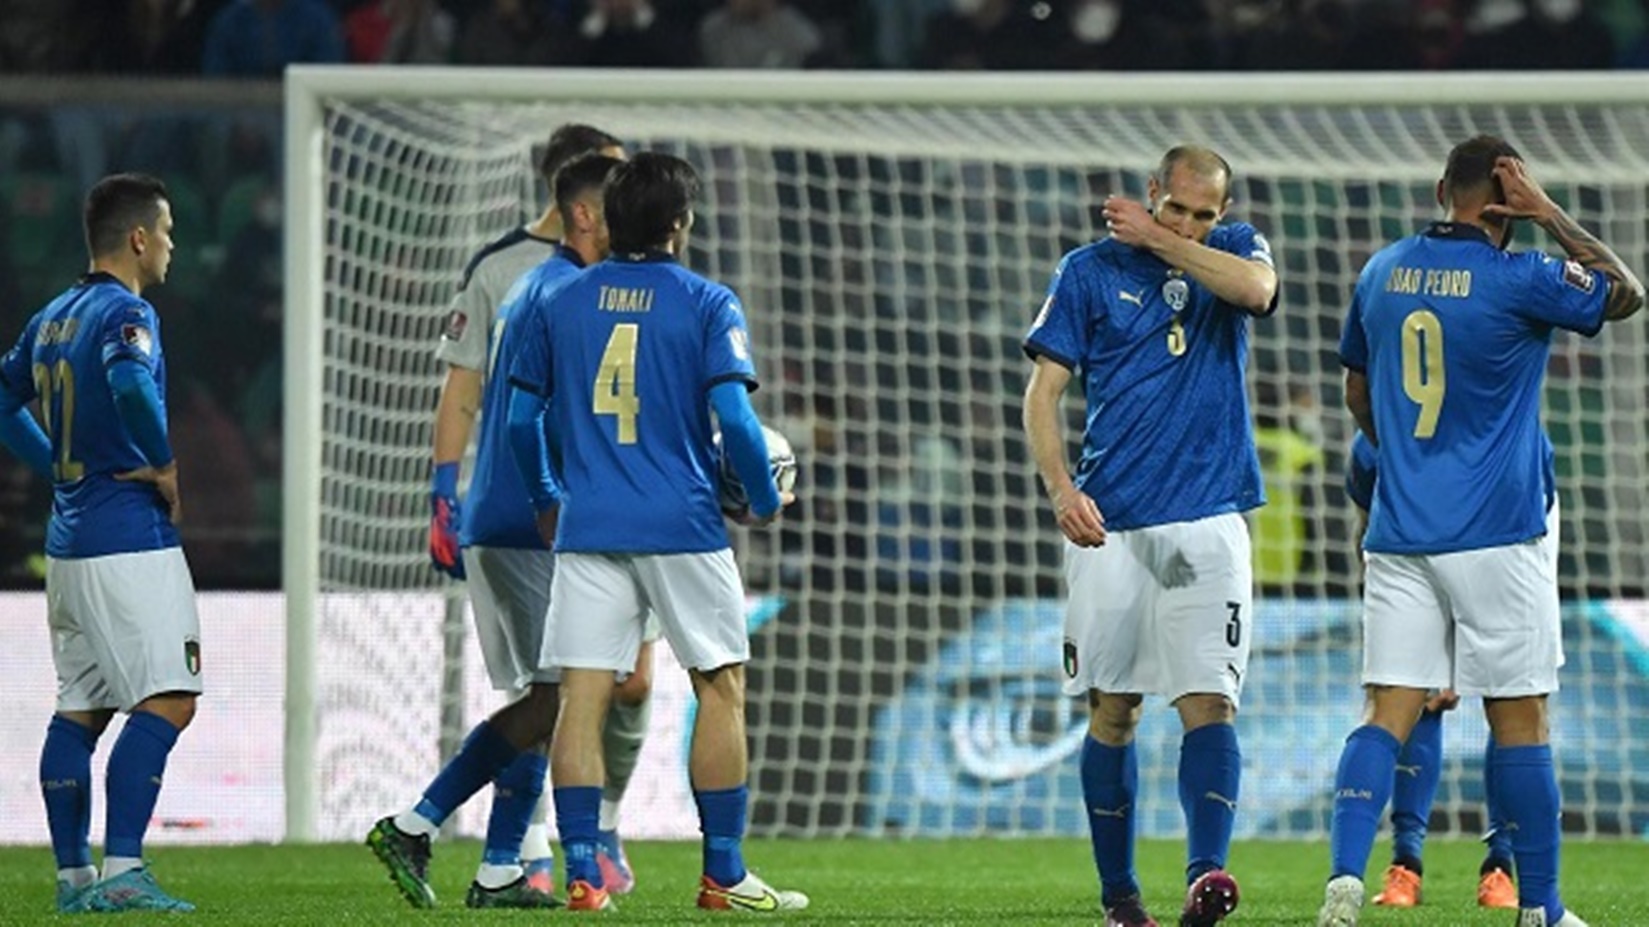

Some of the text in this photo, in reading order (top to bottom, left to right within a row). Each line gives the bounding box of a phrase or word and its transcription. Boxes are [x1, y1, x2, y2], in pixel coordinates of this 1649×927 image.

[598, 285, 654, 313] TONALI
[1423, 268, 1471, 297] PEDRO
[593, 323, 640, 444] 4
[1401, 310, 1445, 438] 9
[1226, 601, 1241, 648] 3
